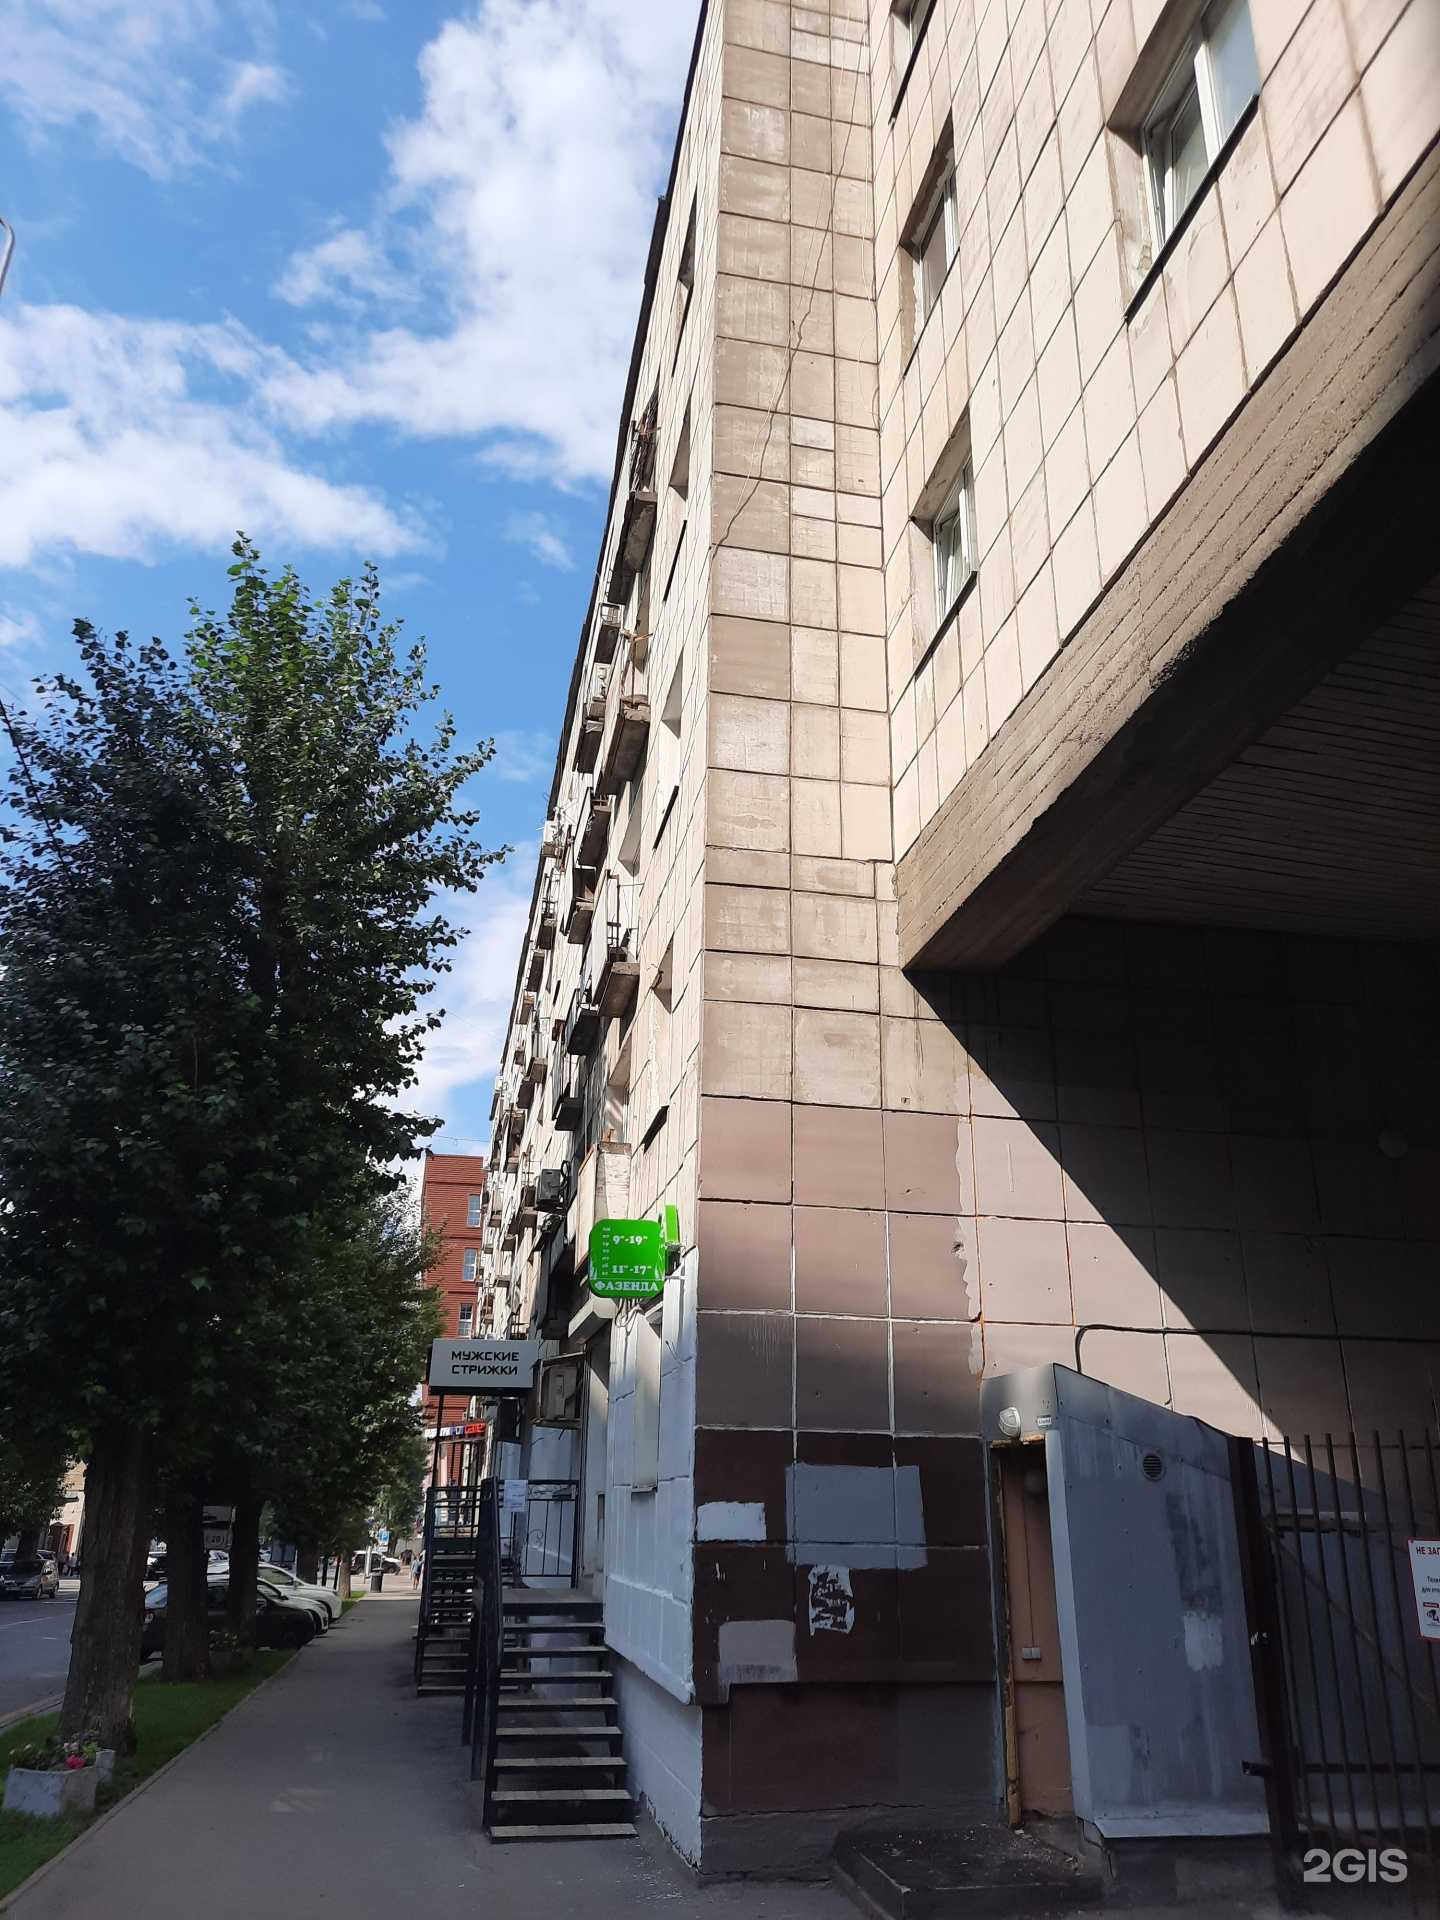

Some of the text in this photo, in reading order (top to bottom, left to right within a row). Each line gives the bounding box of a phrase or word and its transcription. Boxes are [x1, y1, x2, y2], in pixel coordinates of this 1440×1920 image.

[594, 1280, 659, 1292] ФАЗЕНДА
[451, 1351, 520, 1362] МУЖСКИЕ
[451, 1364, 518, 1376] СТРИЖКИ
[1415, 1546, 1425, 1555] НЕ
